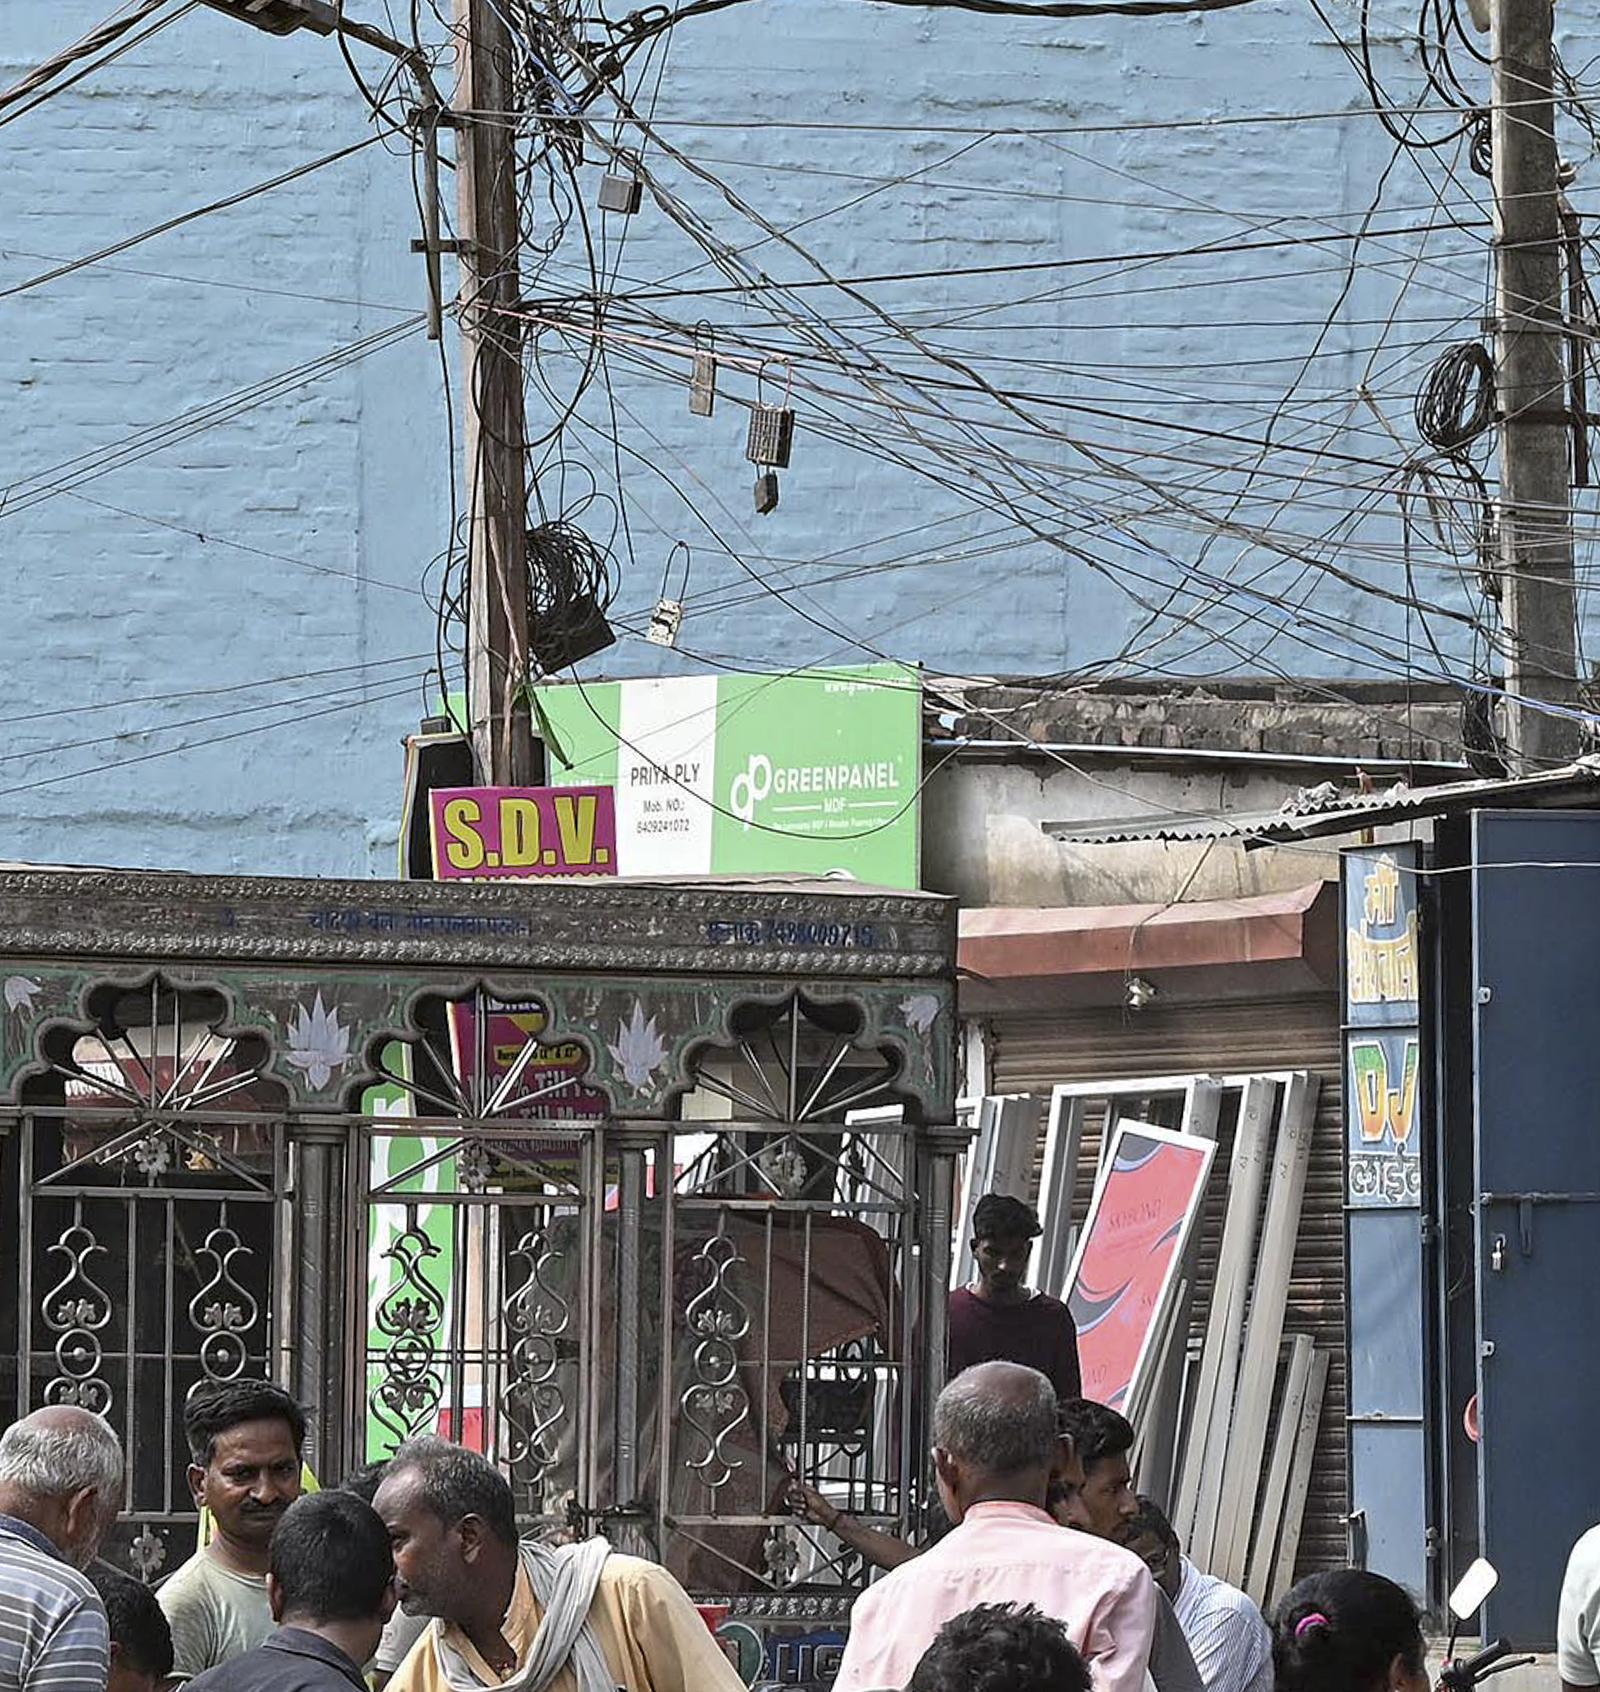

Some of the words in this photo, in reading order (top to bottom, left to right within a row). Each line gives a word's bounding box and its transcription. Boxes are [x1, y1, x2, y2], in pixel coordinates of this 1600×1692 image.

[630, 764, 670, 788] PRIYA
[675, 762, 701, 783] PLY
[773, 761, 901, 794] GREENPANEL
[822, 797, 847, 815] MDF
[443, 795, 610, 870] S.D.V.
[1349, 1040, 1420, 1144] DJ
